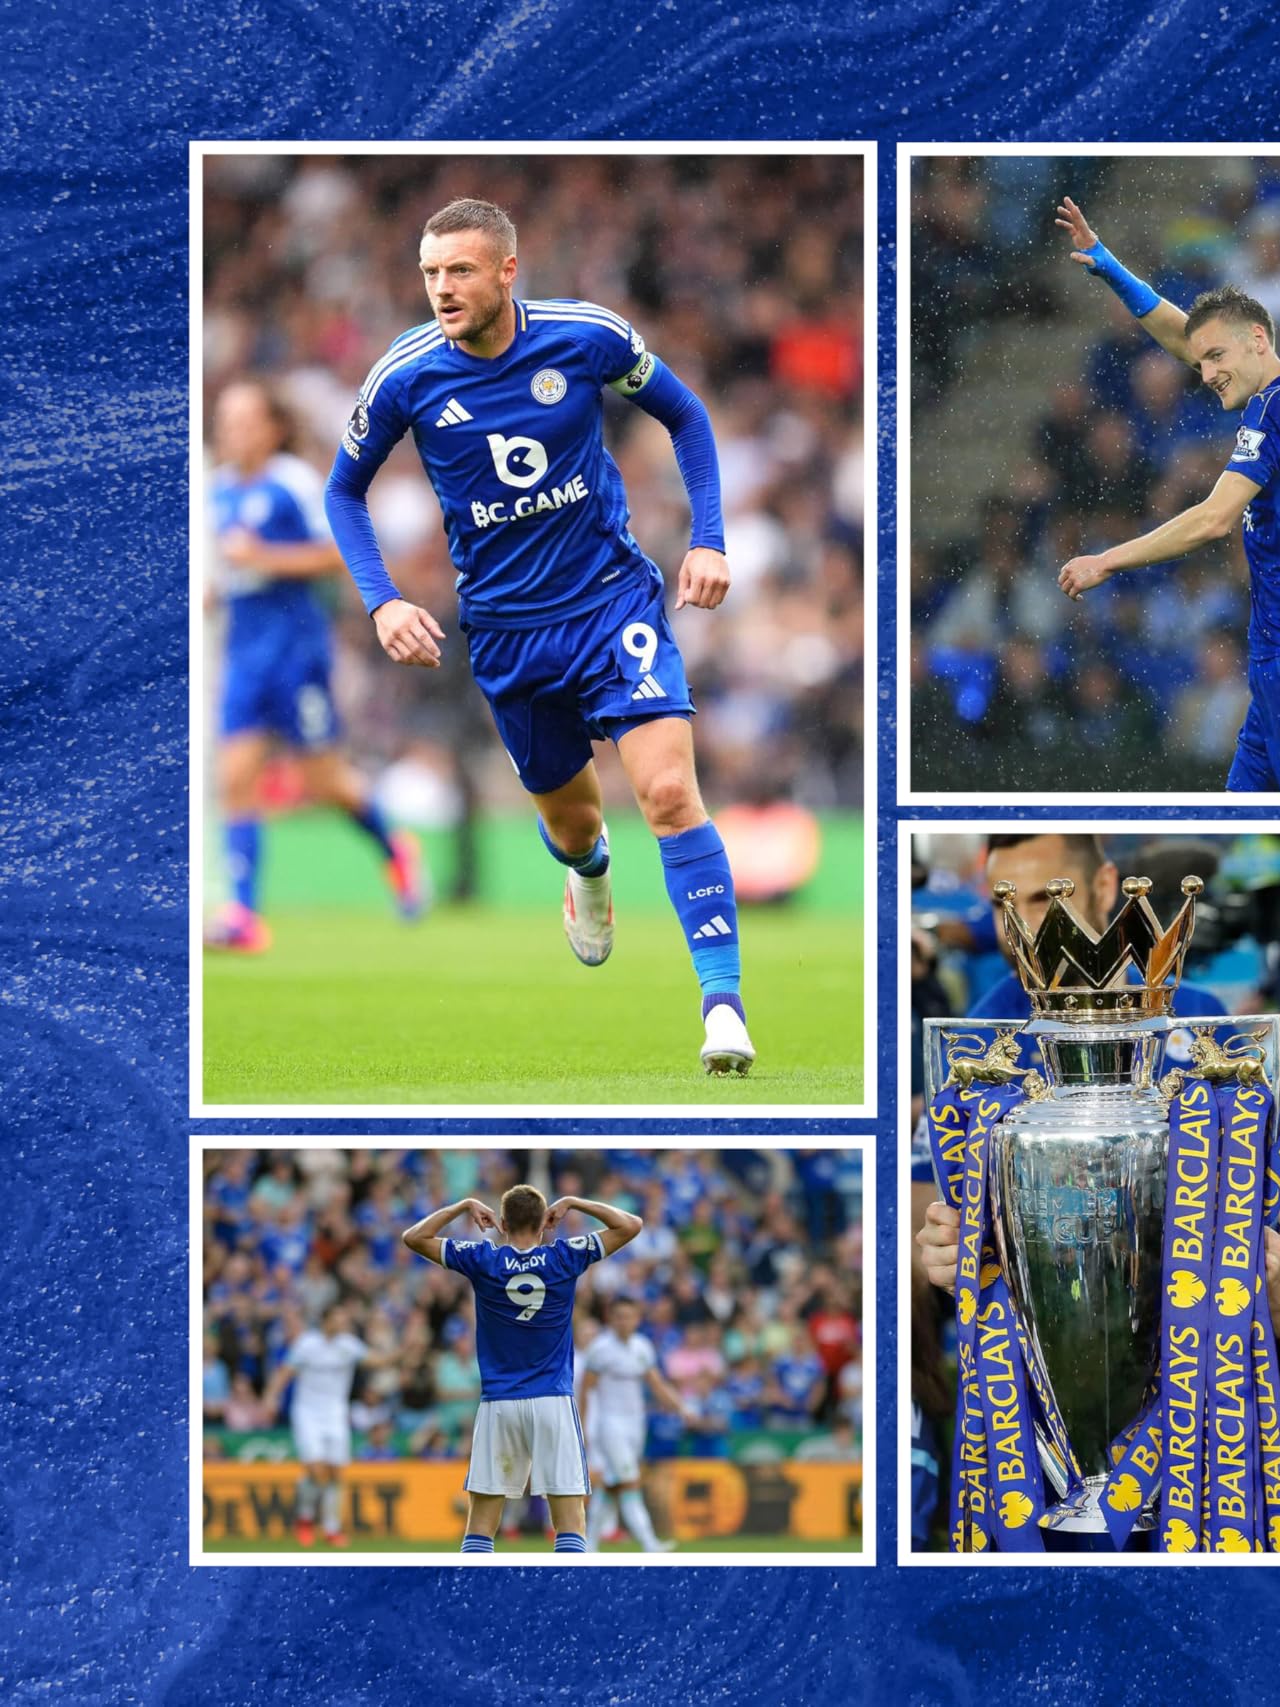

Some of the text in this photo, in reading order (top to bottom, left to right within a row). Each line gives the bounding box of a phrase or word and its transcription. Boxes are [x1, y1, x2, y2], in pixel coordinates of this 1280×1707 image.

[621, 622, 659, 673] 9
[687, 884, 725, 901] LCFC
[504, 1253, 548, 1272] VARDY
[960, 1098, 1001, 1279] BARCLAYS
[1171, 1086, 1212, 1262] BARCLAYS
[1221, 1087, 1266, 1270] BARCLAYS
[505, 1273, 547, 1322] 9
[976, 1300, 1026, 1482] BARCLAYS
[1168, 1325, 1201, 1512] BARCLAYS
[1215, 1333, 1247, 1520] BARCLAYS
